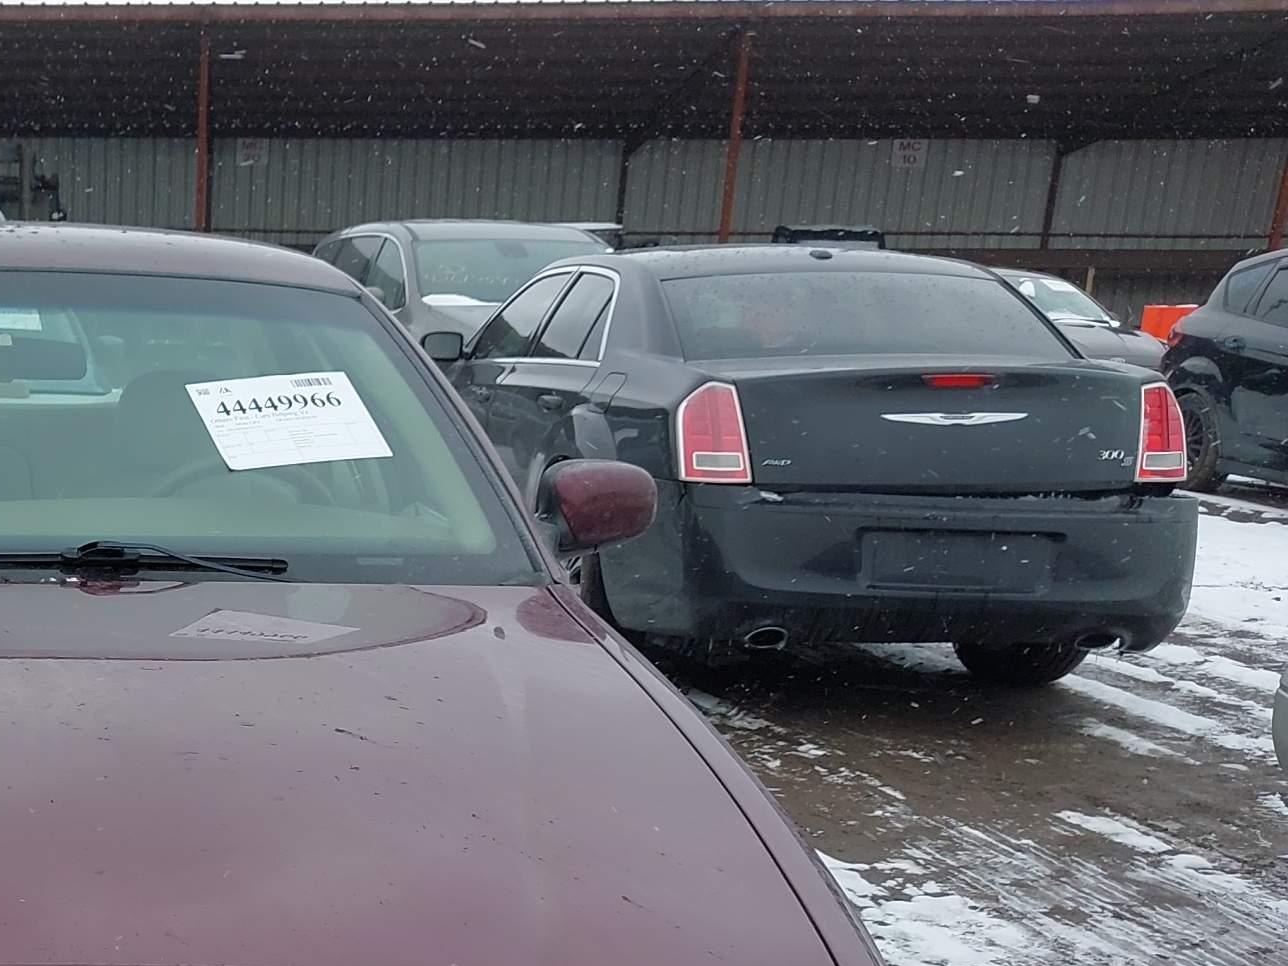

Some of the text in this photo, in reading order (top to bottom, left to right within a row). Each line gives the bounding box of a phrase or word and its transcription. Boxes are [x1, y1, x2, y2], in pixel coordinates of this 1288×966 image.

[899, 141, 921, 151] MC
[903, 154, 917, 165] 10
[216, 391, 343, 416] 44449966
[1098, 449, 1124, 460] 300
